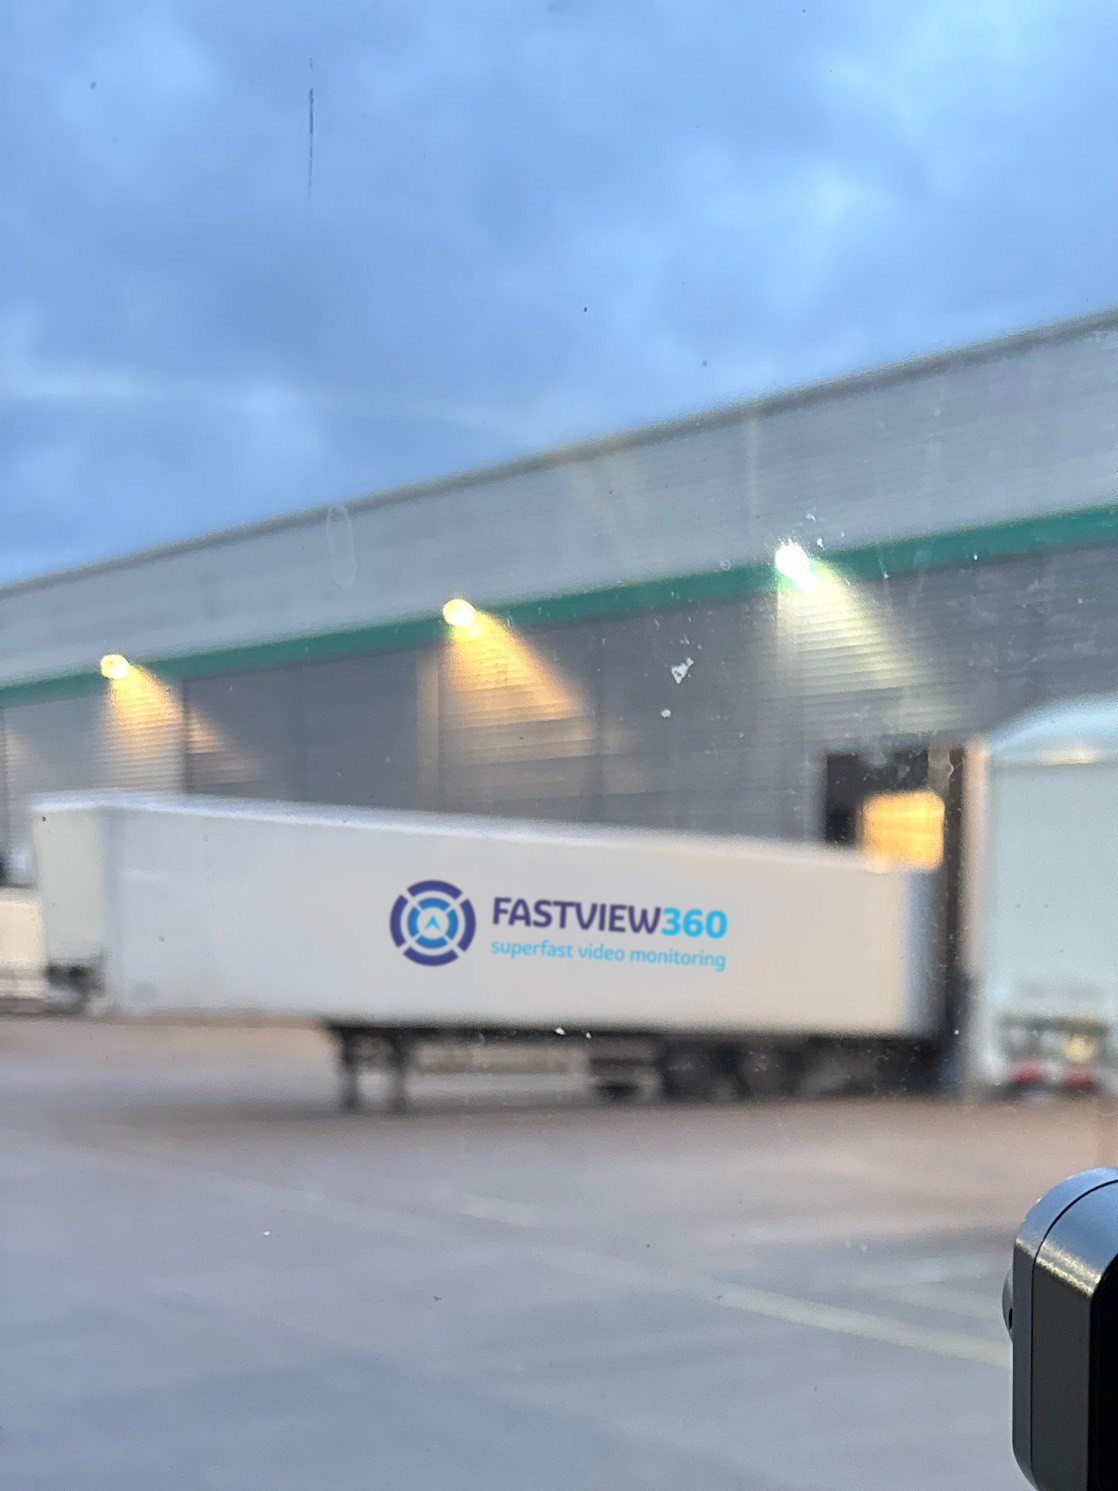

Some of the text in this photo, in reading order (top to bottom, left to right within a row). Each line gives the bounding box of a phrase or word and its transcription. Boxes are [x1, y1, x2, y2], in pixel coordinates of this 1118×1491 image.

[492, 897, 728, 938] FASTVIEW360
[491, 940, 727, 971] superfast video monitoring
